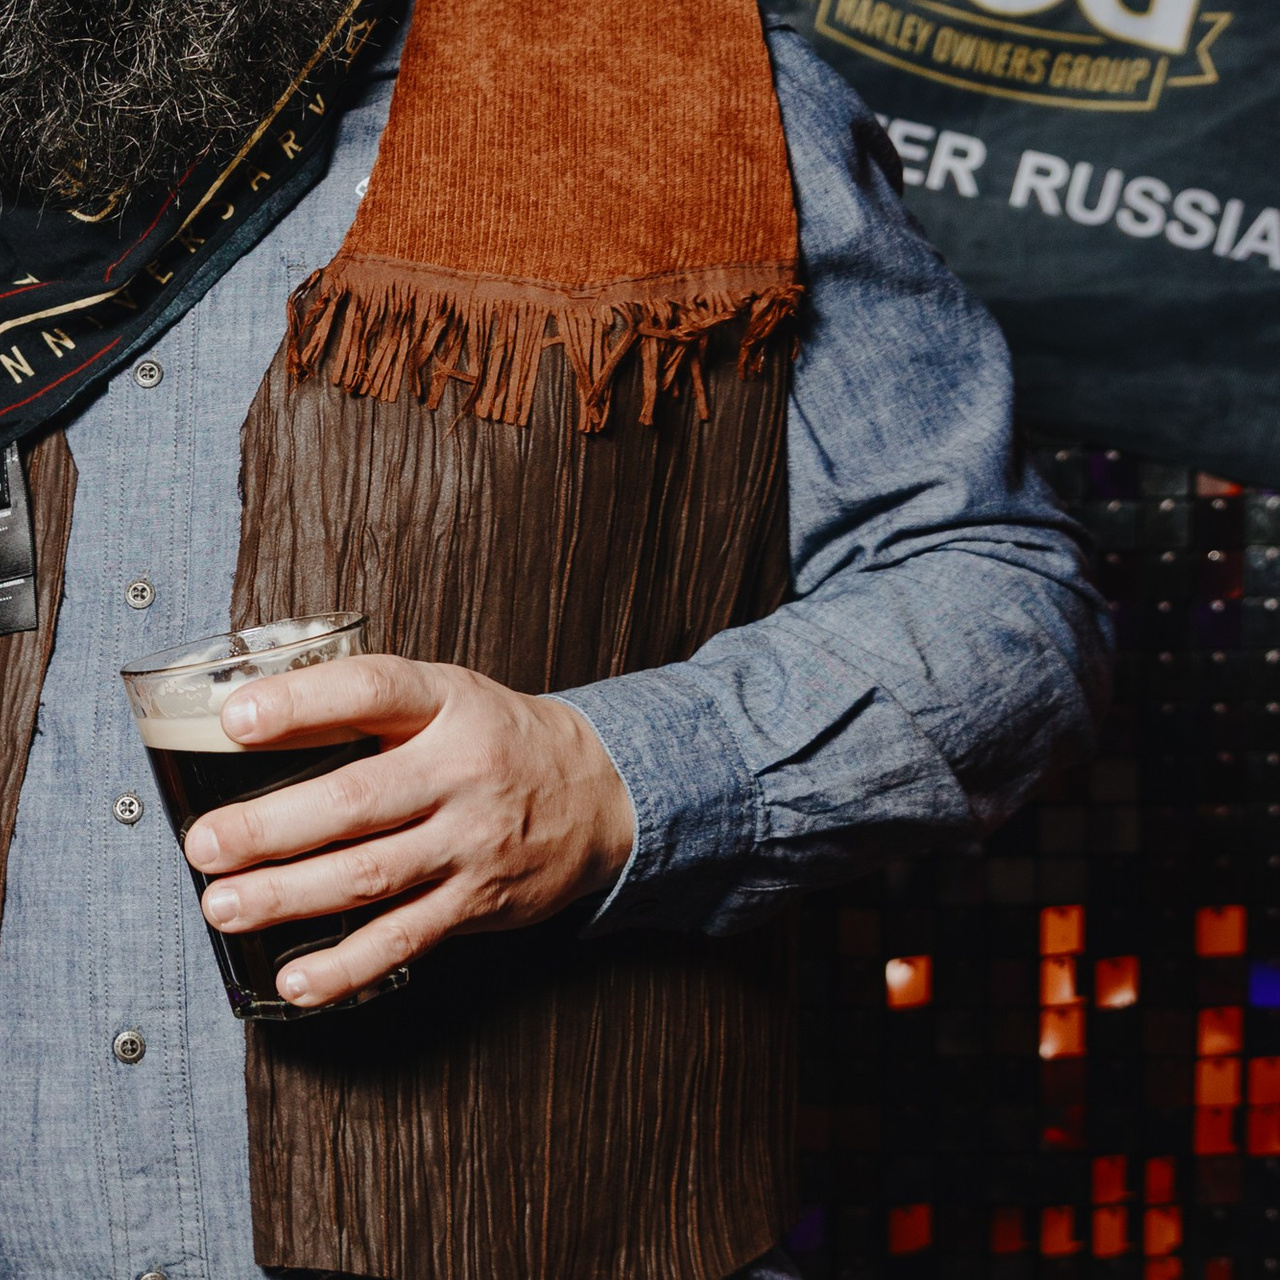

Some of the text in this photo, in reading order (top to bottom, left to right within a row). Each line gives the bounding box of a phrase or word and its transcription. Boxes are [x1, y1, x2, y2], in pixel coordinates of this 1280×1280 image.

[931, 26, 1051, 85] OWNERS
[1048, 51, 1152, 95] GROUP
[874, 112, 1280, 271] ER RUSSIA
